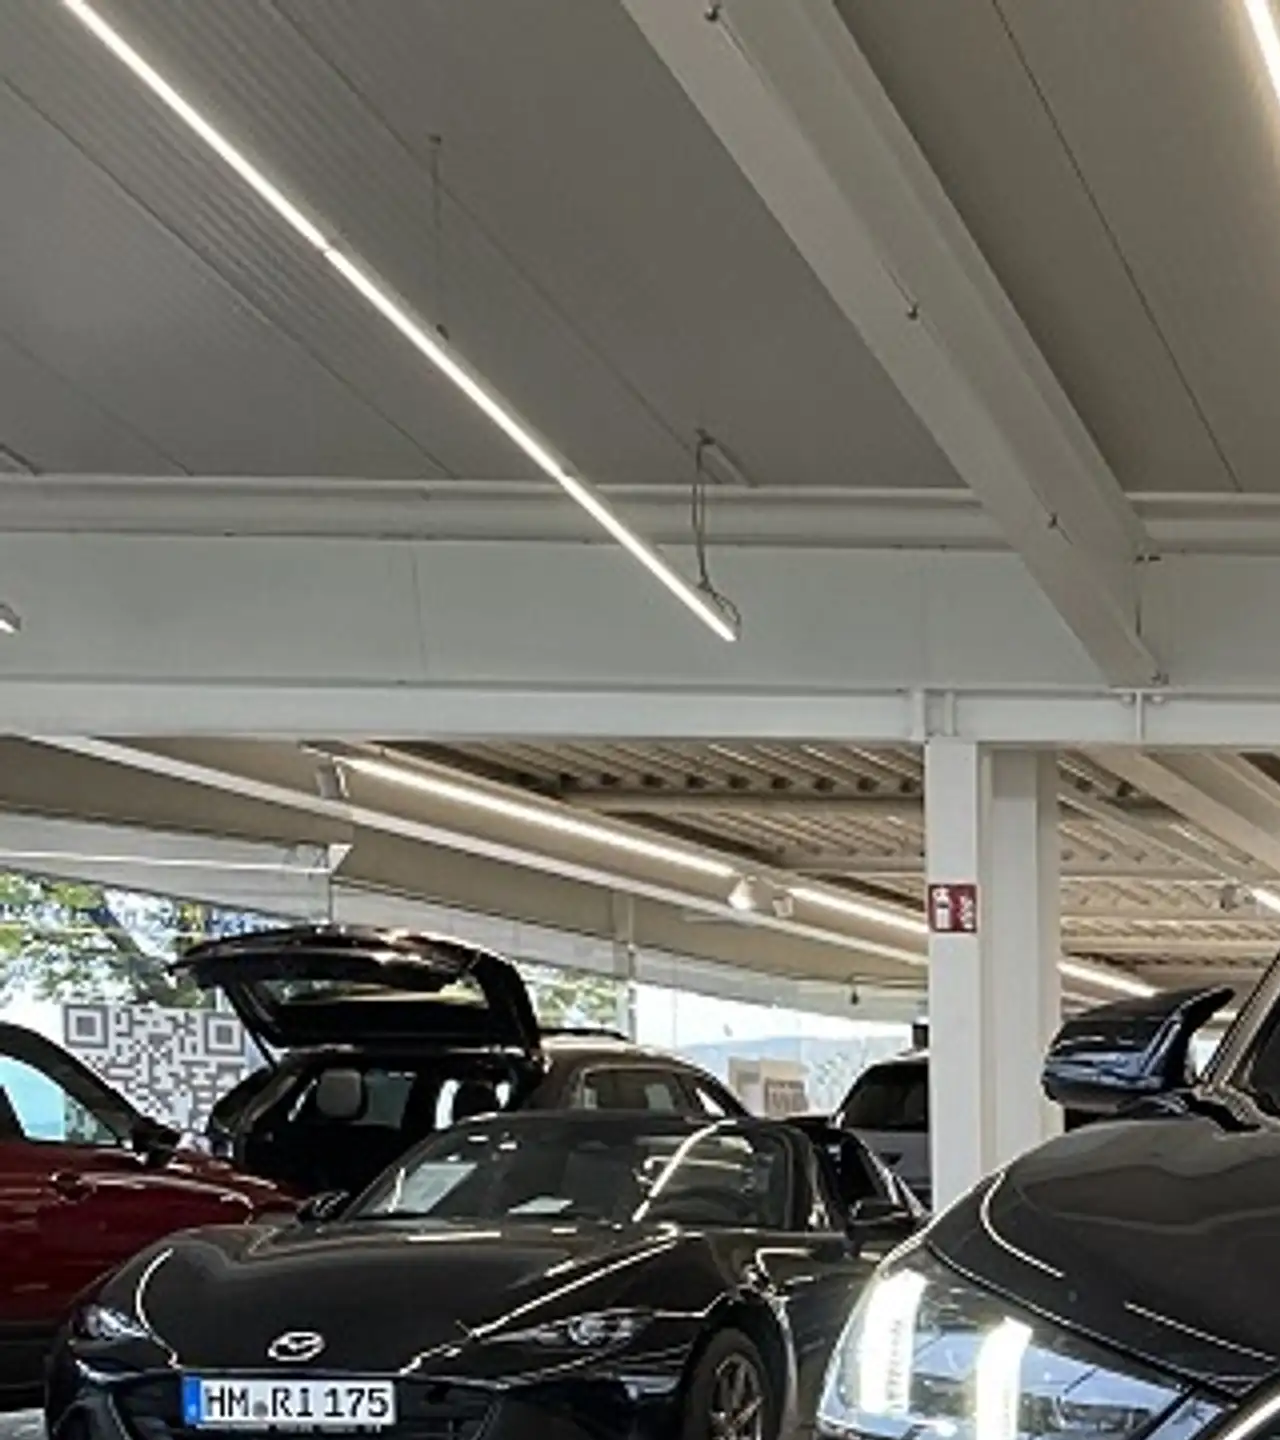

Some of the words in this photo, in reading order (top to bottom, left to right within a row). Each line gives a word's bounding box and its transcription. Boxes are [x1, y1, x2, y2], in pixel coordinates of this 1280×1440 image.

[203, 1386, 249, 1417] HM
[271, 1387, 314, 1417] RI
[323, 1387, 389, 1418] 175
